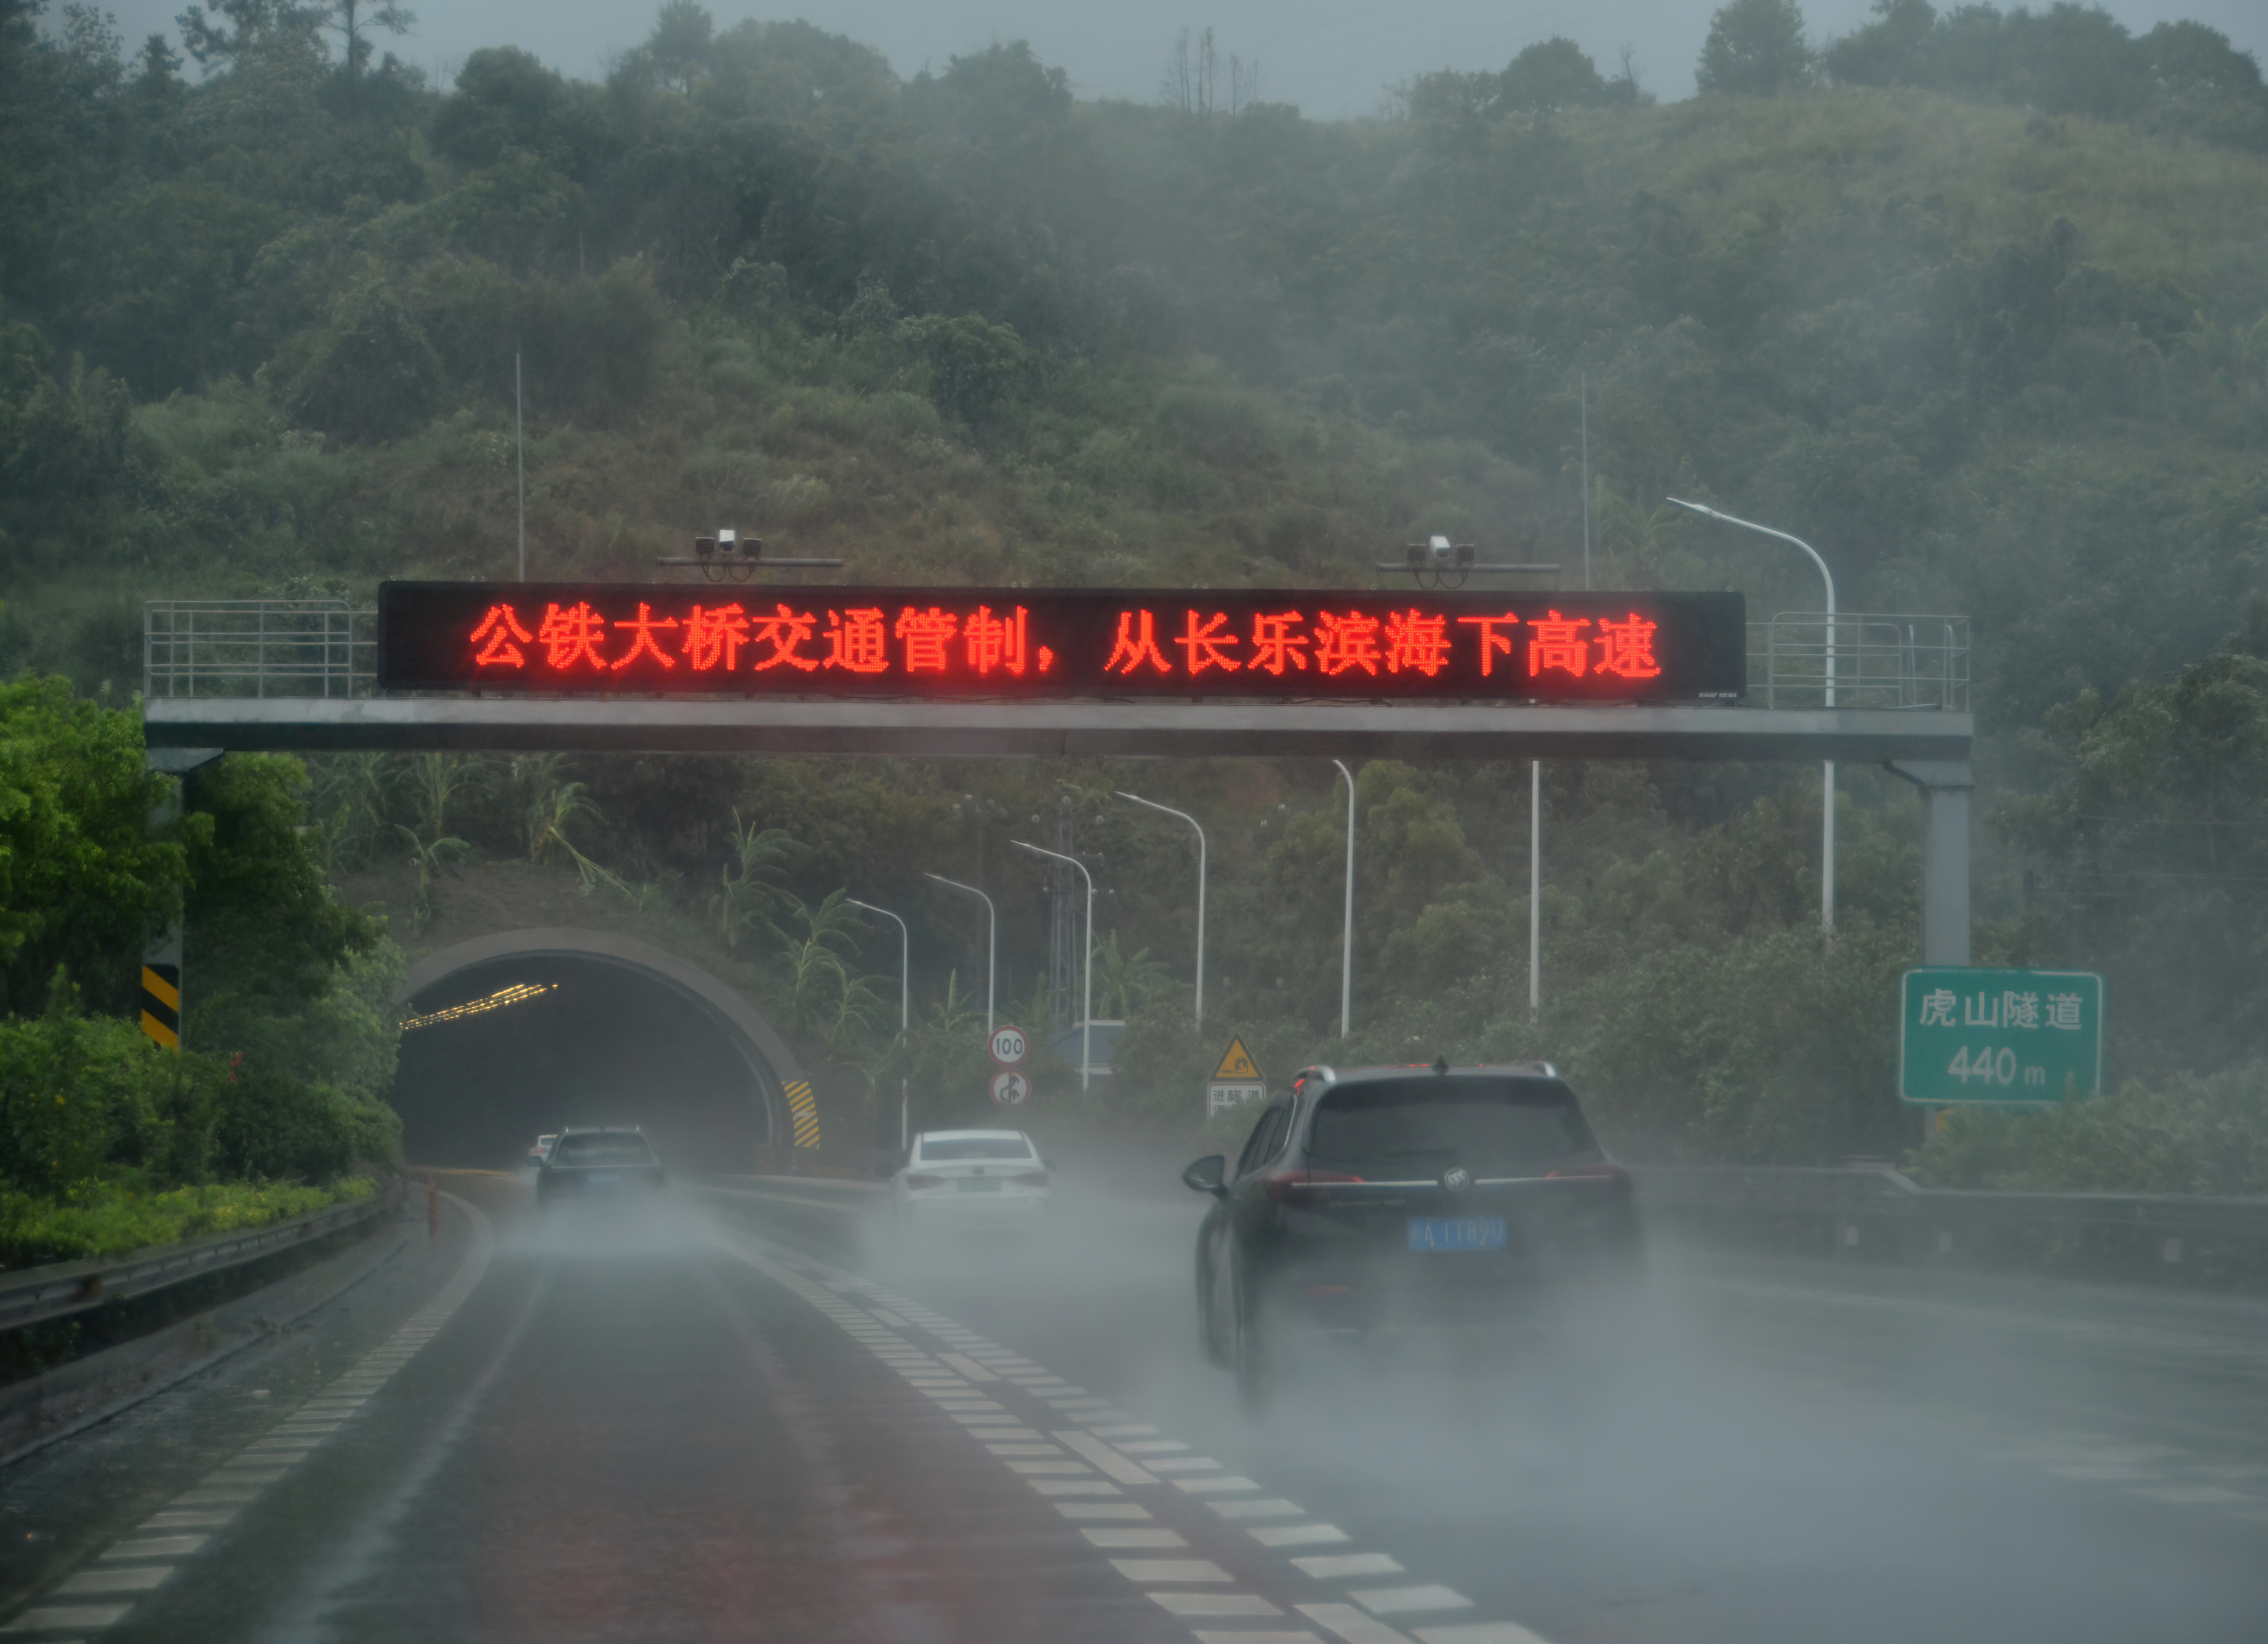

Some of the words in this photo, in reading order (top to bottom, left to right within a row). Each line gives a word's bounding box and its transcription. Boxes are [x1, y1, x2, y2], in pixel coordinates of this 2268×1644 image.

[1919, 988, 2082, 1029] 虎山隧道
[996, 1038, 1023, 1054] 100
